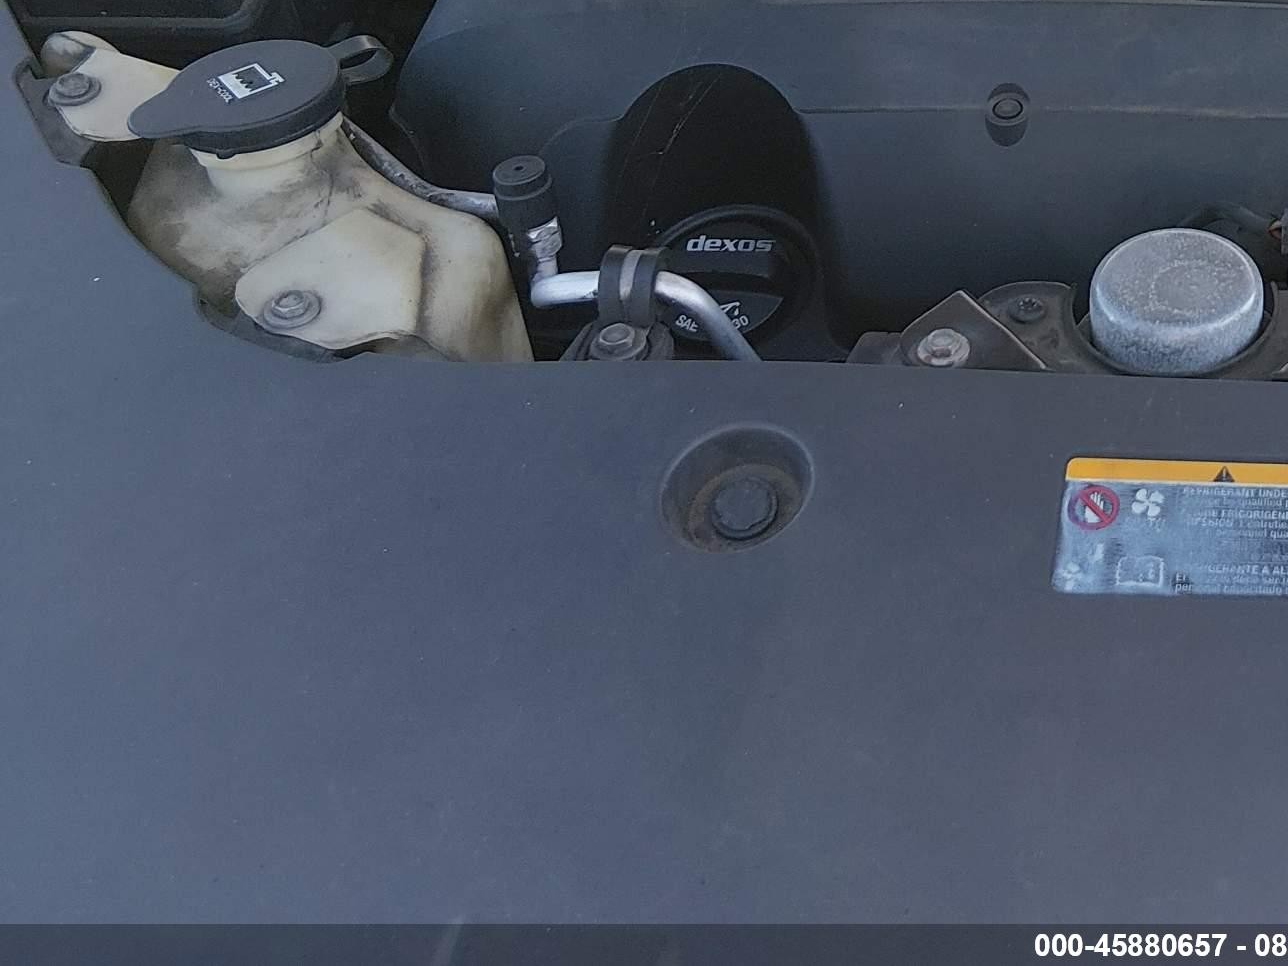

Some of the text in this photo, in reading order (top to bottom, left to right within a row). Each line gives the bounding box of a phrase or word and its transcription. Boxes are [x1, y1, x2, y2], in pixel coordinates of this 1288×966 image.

[686, 235, 776, 252] dexos
[675, 314, 699, 332] SAE
[1261, 566, 1270, 575] A
